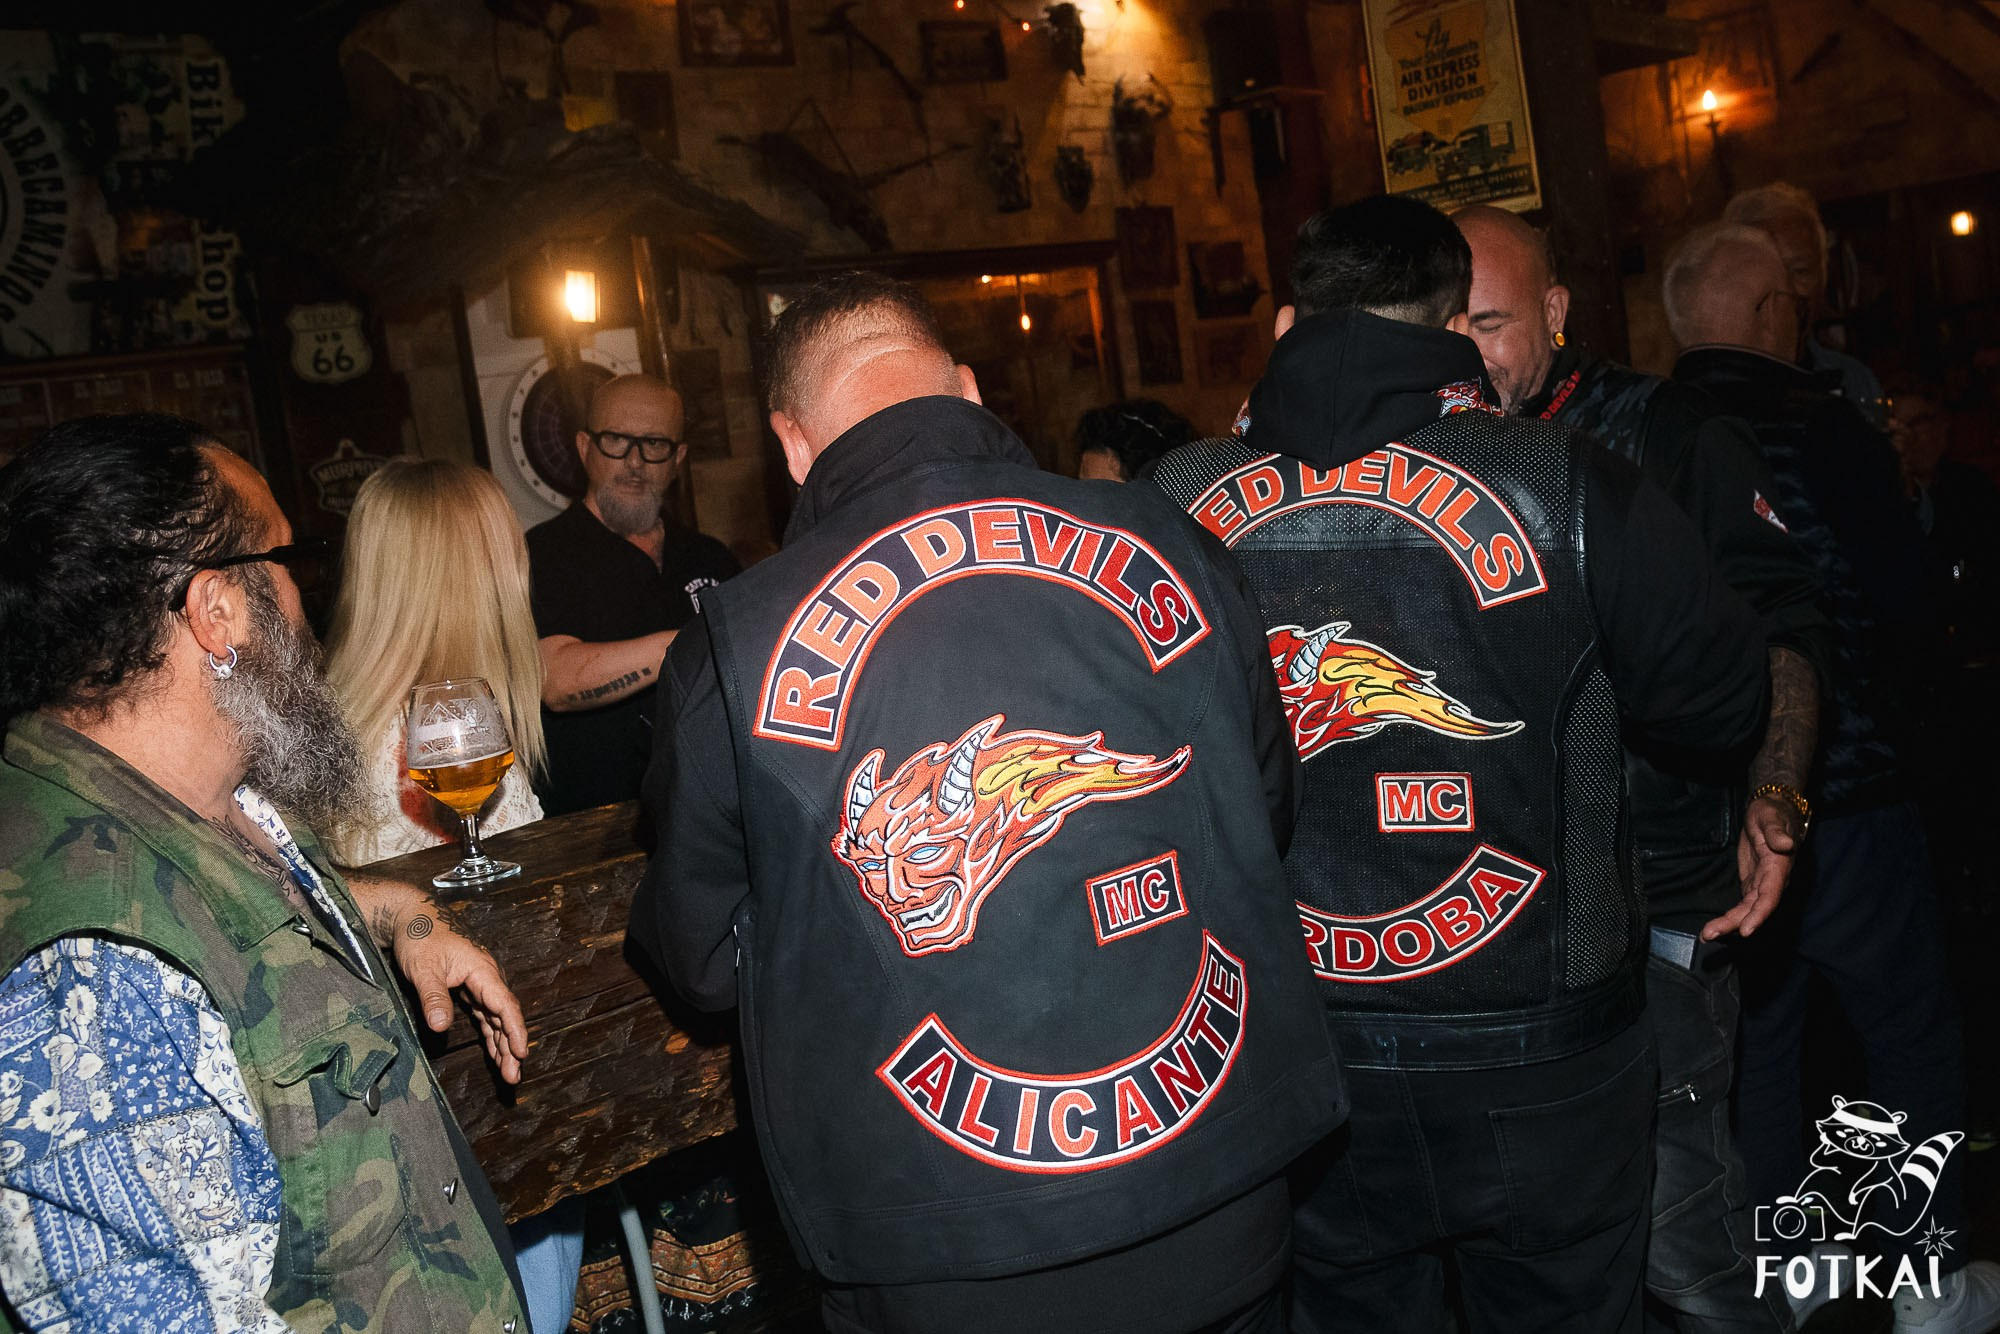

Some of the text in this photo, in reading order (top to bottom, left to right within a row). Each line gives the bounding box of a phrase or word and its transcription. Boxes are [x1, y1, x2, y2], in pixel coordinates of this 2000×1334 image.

[1401, 54, 1480, 87] AIR EXPRESS
[1408, 72, 1477, 101] DIVISION
[314, 345, 354, 375] 66
[1547, 381, 1576, 414] DEVILS
[1298, 451, 1524, 592] DEVILS
[769, 509, 1189, 730] RED DEVILS
[1384, 780, 1465, 822] MC
[1102, 872, 1169, 931] MC
[902, 955, 1242, 1157] ALICANTE
